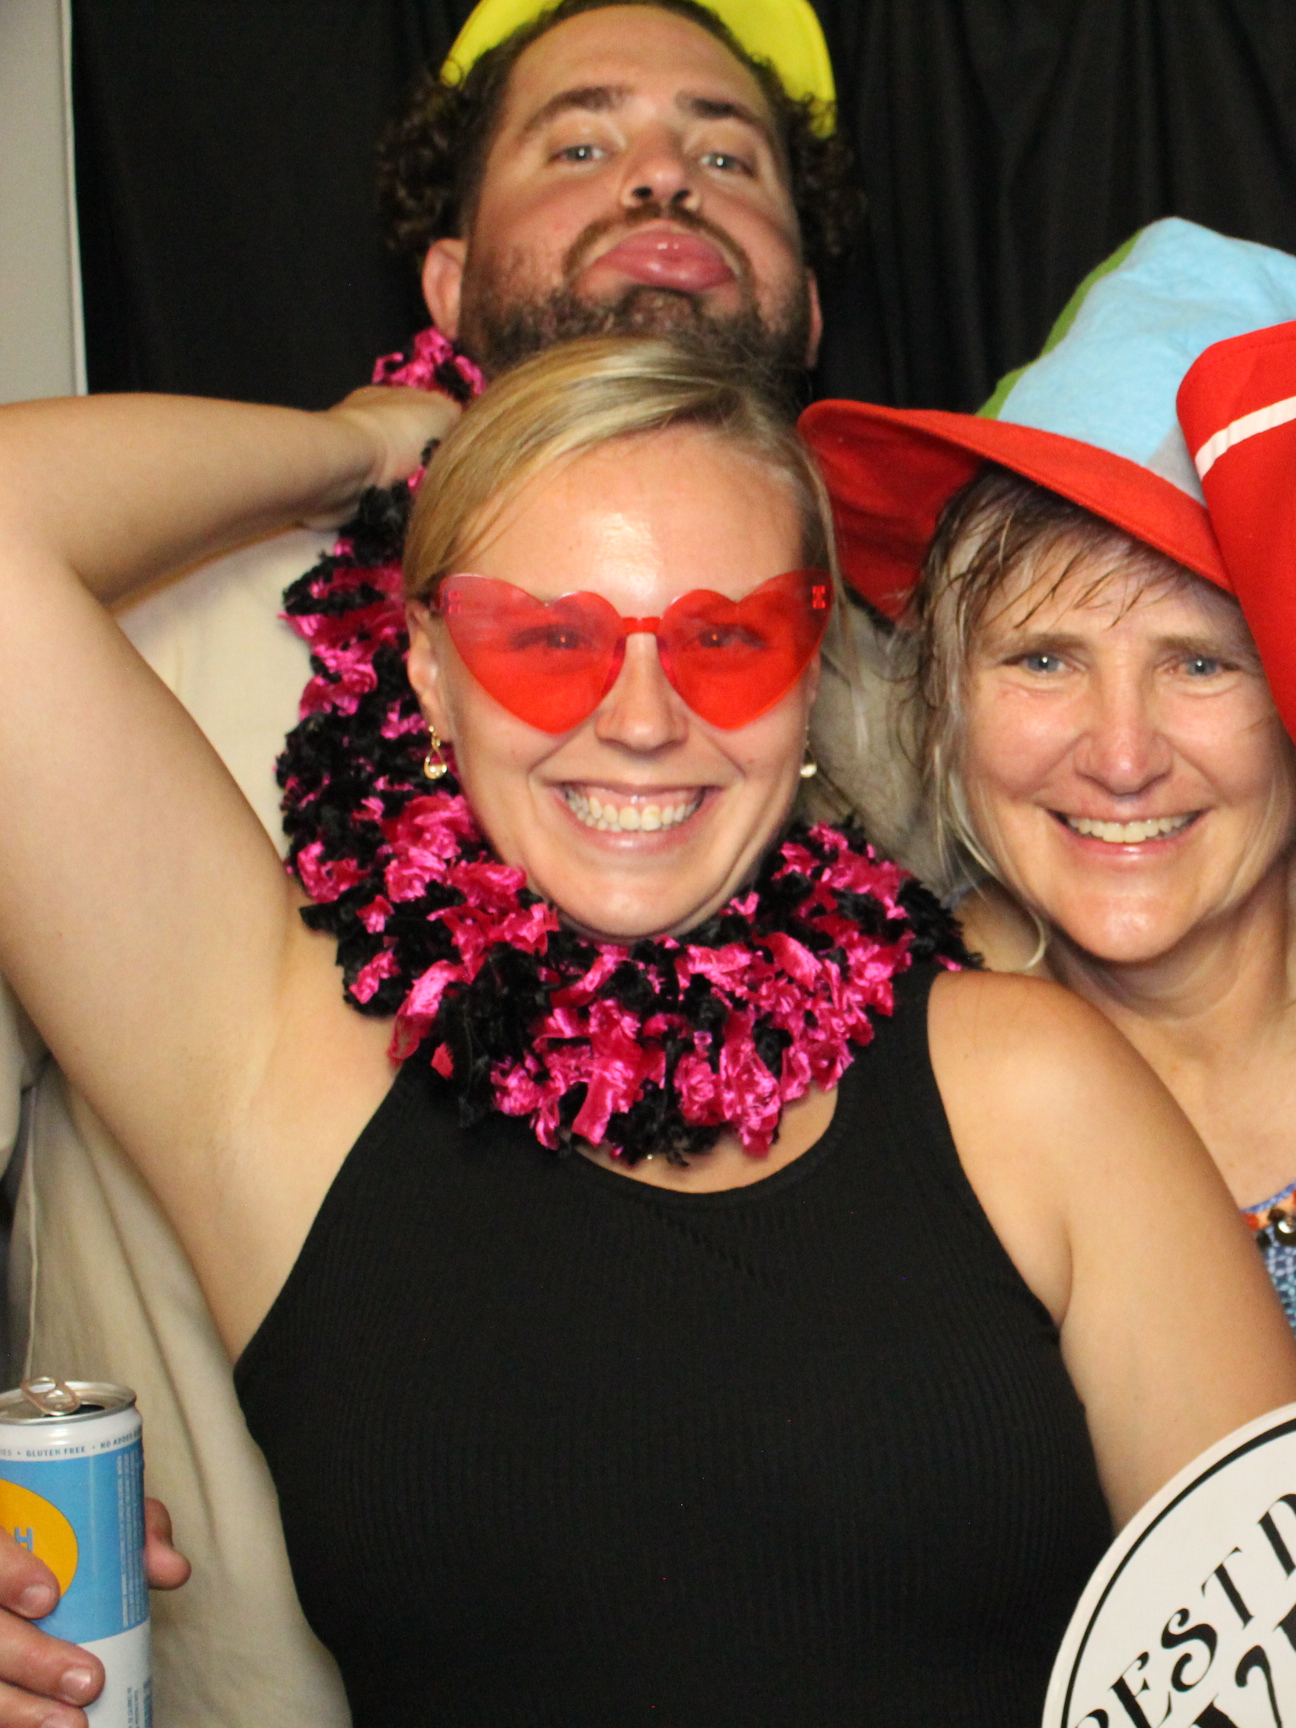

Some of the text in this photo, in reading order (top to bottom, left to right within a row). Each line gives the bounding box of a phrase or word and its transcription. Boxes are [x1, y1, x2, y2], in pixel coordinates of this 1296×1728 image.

[26, 1449, 61, 1458] GLUTEN
[64, 1445, 85, 1455] FREE
[14, 1526, 34, 1552] H
